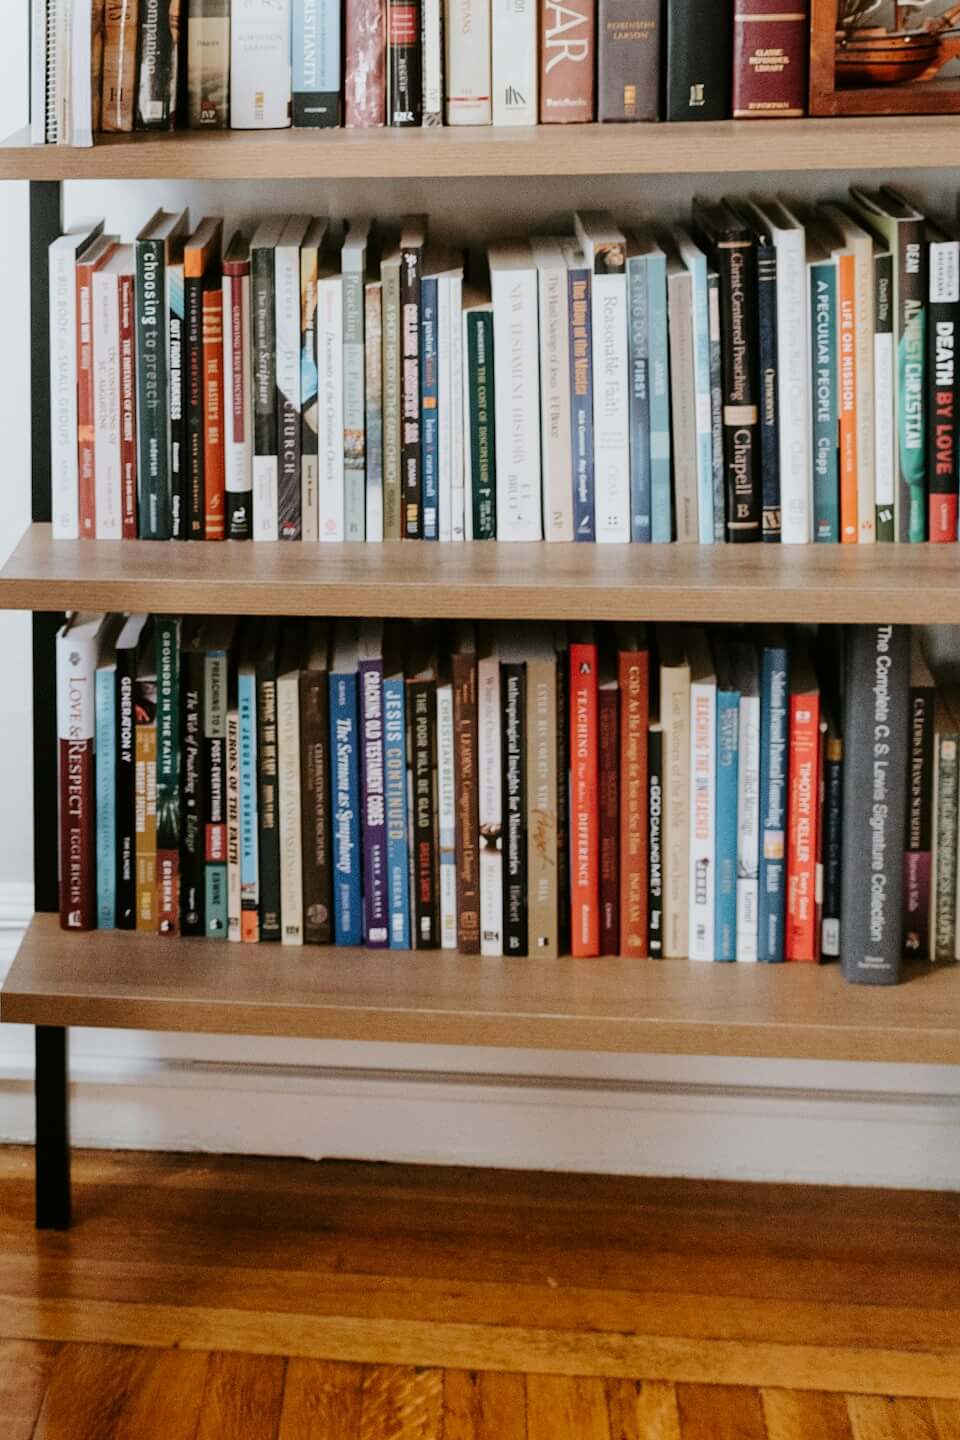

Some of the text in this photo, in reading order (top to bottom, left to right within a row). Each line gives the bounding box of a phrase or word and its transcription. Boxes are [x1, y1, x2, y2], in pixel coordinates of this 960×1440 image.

[258, 290, 267, 306] The
[877, 278, 889, 321] David Day
[905, 243, 919, 273] DEAN
[139, 252, 160, 409] choosing to preach
[170, 318, 181, 420] OUT FROM DARKNESS
[233, 305, 244, 416] GROWING TRUE DISCIPLES
[258, 310, 268, 340] Drama
[602, 296, 618, 376] Reasonable
[730, 252, 747, 401] Christ-Centered Preaching
[816, 280, 830, 423] A PECULIAR PEOPLE
[842, 300, 853, 411] LIFE ON MISSION
[255, 350, 269, 404] Scripture
[904, 363, 921, 449] CHRISTIAN
[935, 321, 954, 476] DEATH BY LOVE
[283, 401, 295, 474] CHURCH
[406, 457, 417, 488] BOMAR
[730, 429, 751, 495] Chapell
[814, 437, 830, 475] Clapp
[68, 676, 86, 721] LOVE
[121, 677, 132, 749] GENERATION
[161, 631, 172, 775] GROUNDED IN THE FAITH
[66, 740, 89, 817] RESPECT
[228, 720, 239, 865] HEROES OF THE FAITH
[334, 718, 354, 875] The Sermon as Symphony
[416, 692, 429, 828] THE POOR WILL BE GLAD
[440, 698, 452, 816] CHRISTIAN BELIEFS
[576, 687, 588, 887] TEACHING DIFFERENCE
[671, 691, 685, 829] Lost Women of the Bible
[695, 696, 708, 840] REACHING THE UNREACHED
[867, 625, 892, 942] The Complete C. S. Lewis Signature Collection
[799, 761, 811, 862] TIMOTHY KELLER
[69, 827, 81, 903] EGGERICHS
[161, 859, 172, 912] ERISMAN
[628, 873, 640, 923] INGRAM
